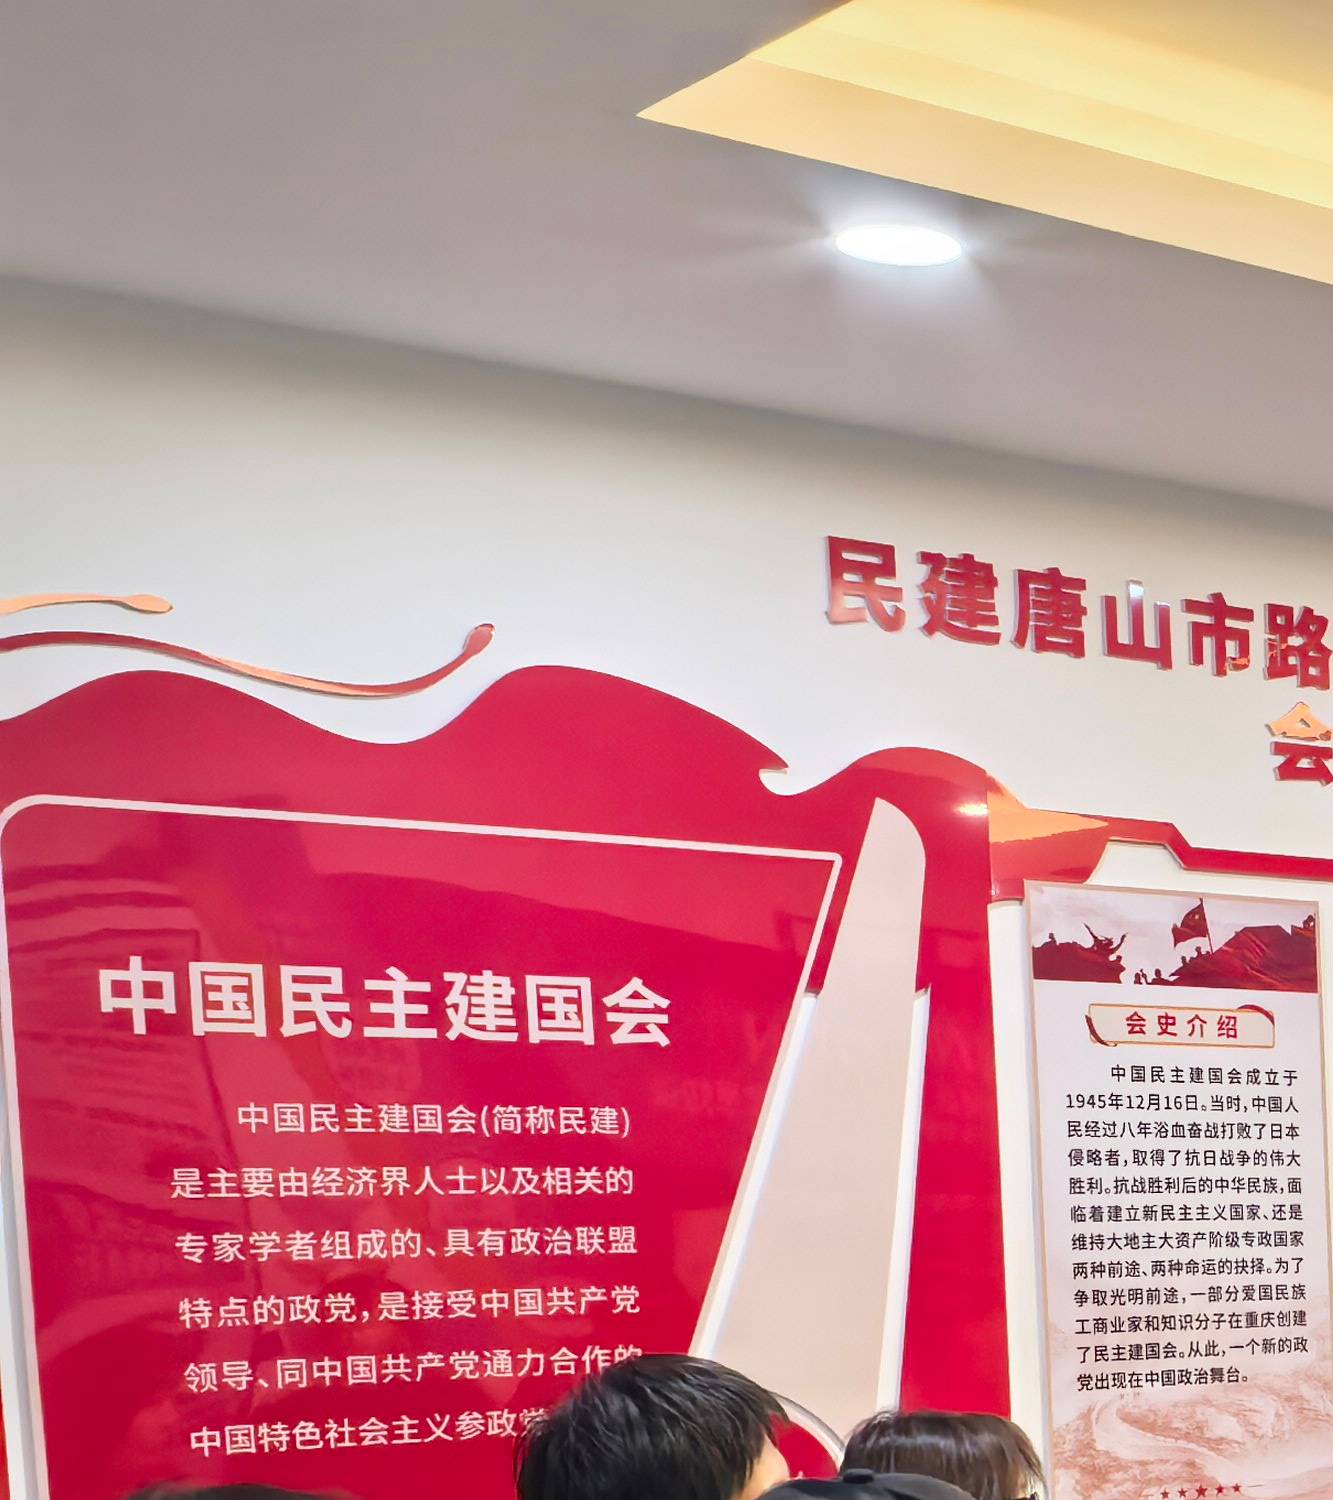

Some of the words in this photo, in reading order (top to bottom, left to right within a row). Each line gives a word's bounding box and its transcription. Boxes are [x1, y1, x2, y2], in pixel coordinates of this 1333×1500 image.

[98, 955, 673, 1047] 中国民主建国会
[1125, 1012, 1238, 1039] 会史介绍
[1111, 1064, 1298, 1087] 中国民主建国会成立于
[1067, 1120, 1300, 1140] 民经过八年浴血奋战打败了日本
[170, 1166, 634, 1200] 是主要由经济界人士以及相关的
[176, 1226, 638, 1263] 专家学者组成的、具有政治联盟
[1071, 1230, 1304, 1251] 维持大地主大资产阶级专政国家
[179, 1285, 641, 1330] 特点的政党，是接受中国共产党
[1075, 1310, 1307, 1335] 工商业家和知识分子在重庆创建
